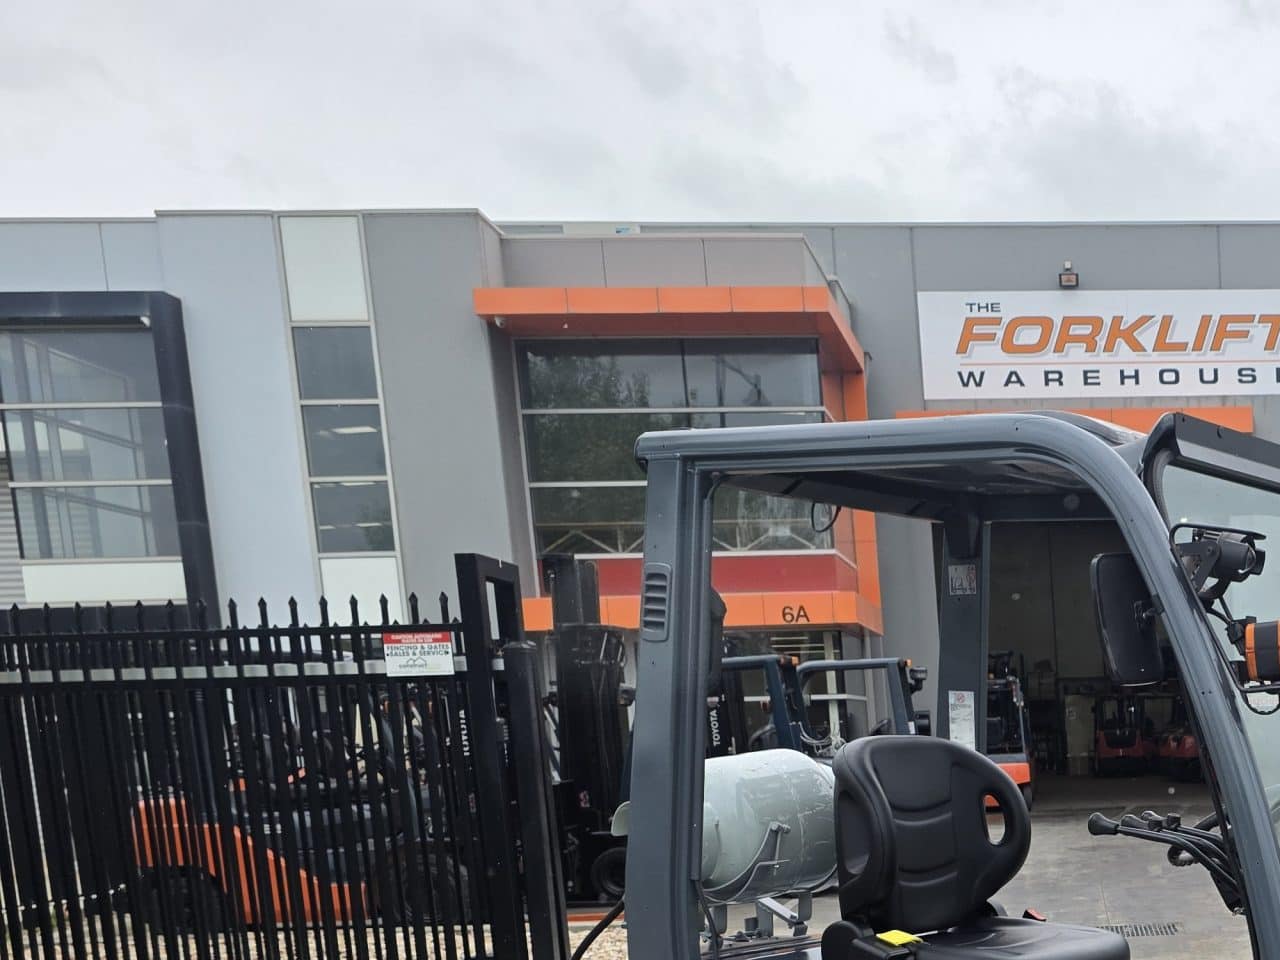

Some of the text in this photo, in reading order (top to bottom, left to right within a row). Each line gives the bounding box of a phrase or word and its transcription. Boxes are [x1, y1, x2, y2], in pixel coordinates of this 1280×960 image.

[965, 302, 1001, 313] THE
[782, 604, 810, 623] 6A
[710, 709, 721, 747] TOYOTA
